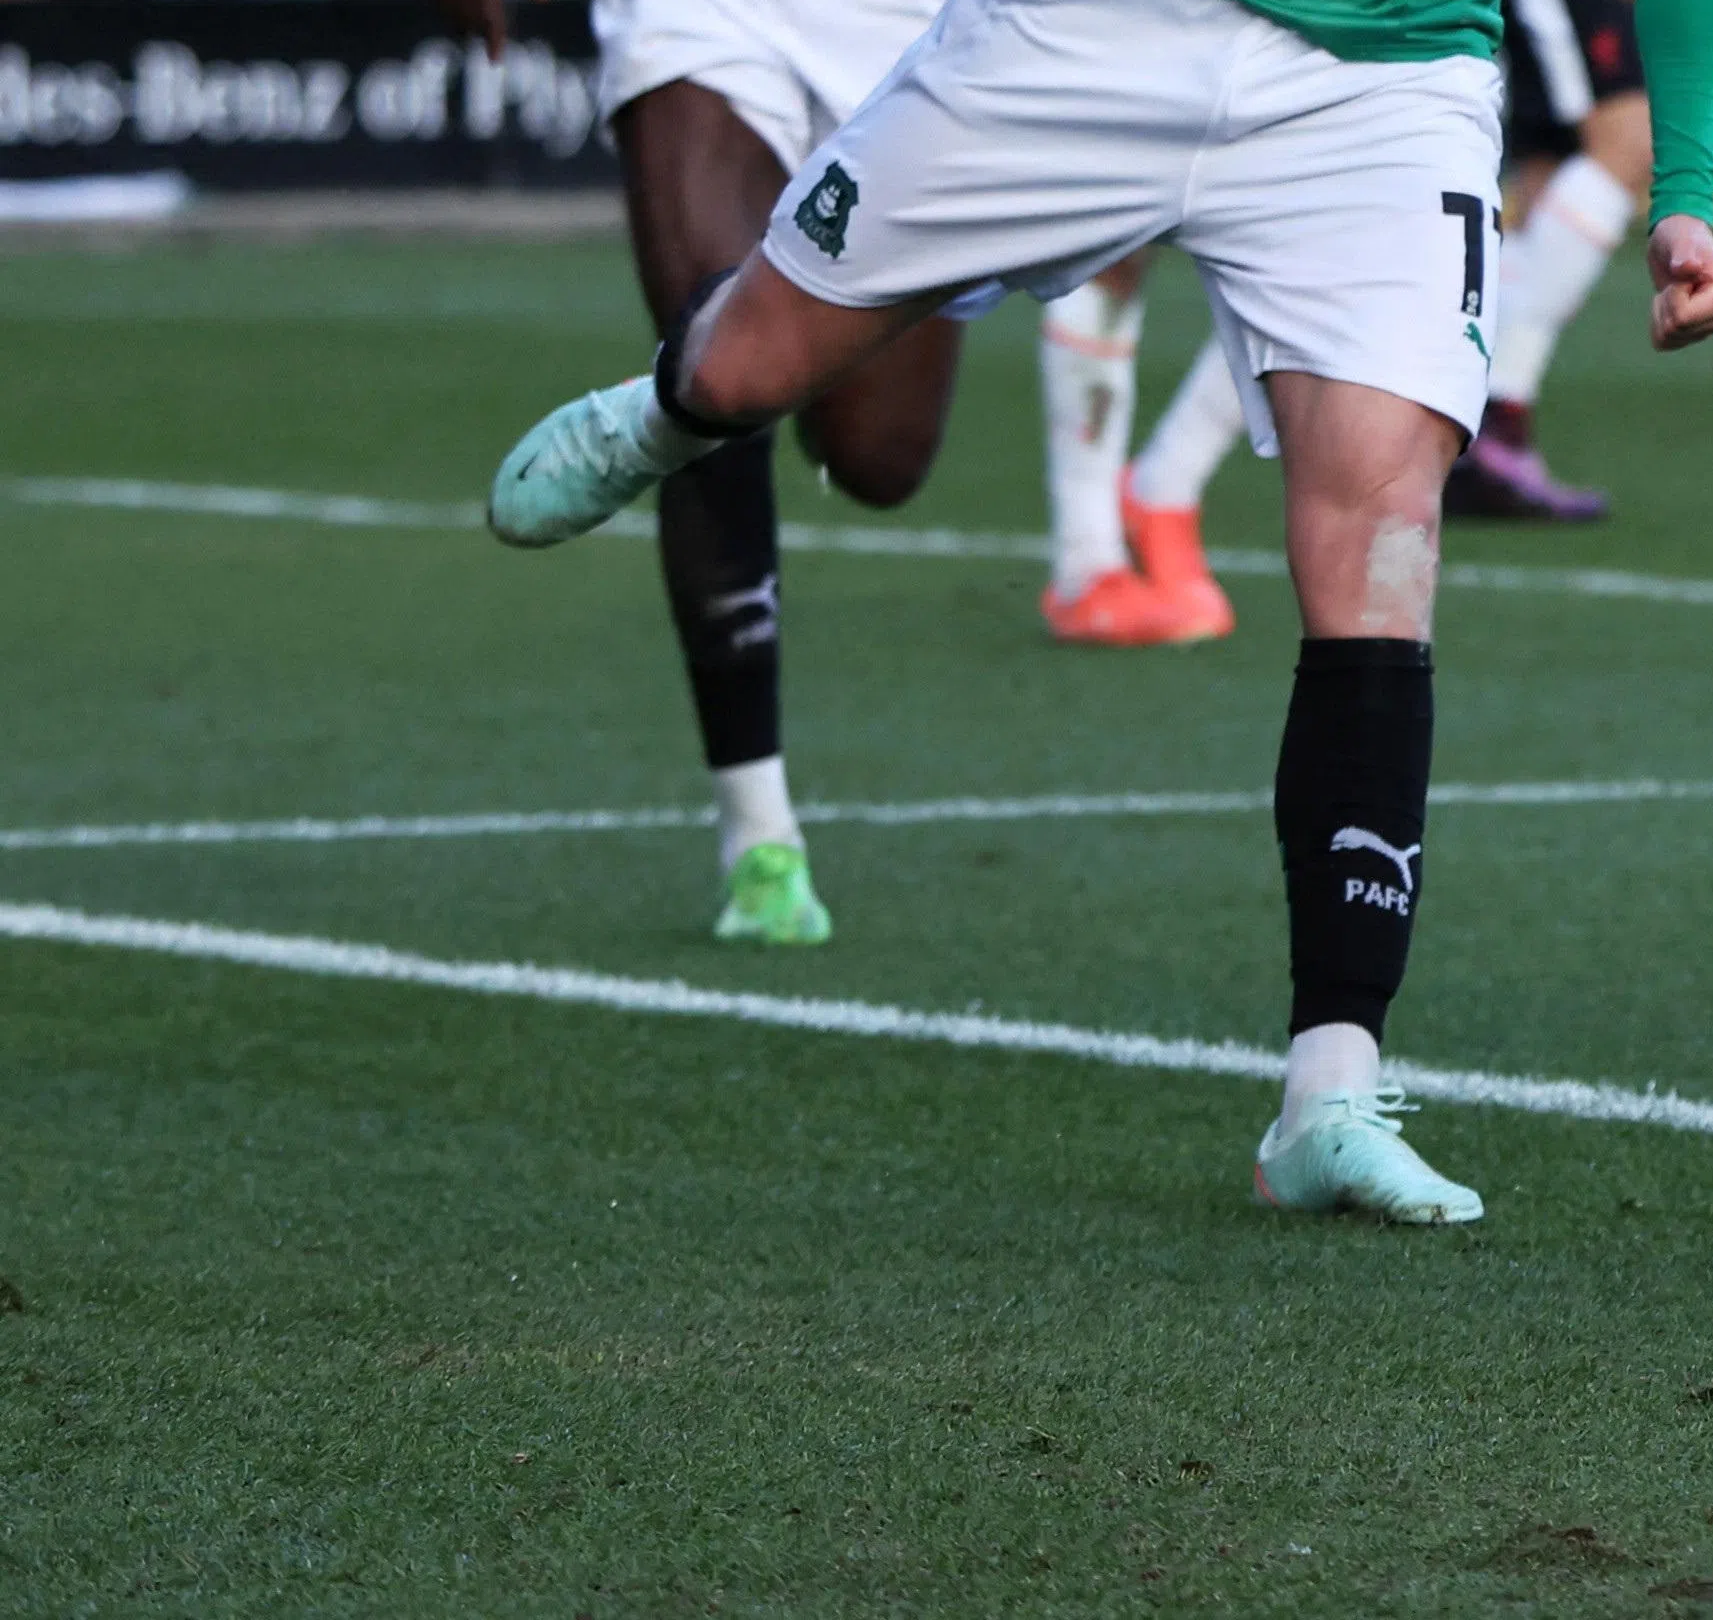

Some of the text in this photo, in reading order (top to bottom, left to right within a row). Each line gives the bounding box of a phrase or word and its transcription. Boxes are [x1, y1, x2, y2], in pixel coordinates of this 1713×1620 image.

[357, 38, 452, 140] of
[465, 40, 598, 158] Ply
[1344, 878, 1410, 916] PAFC
